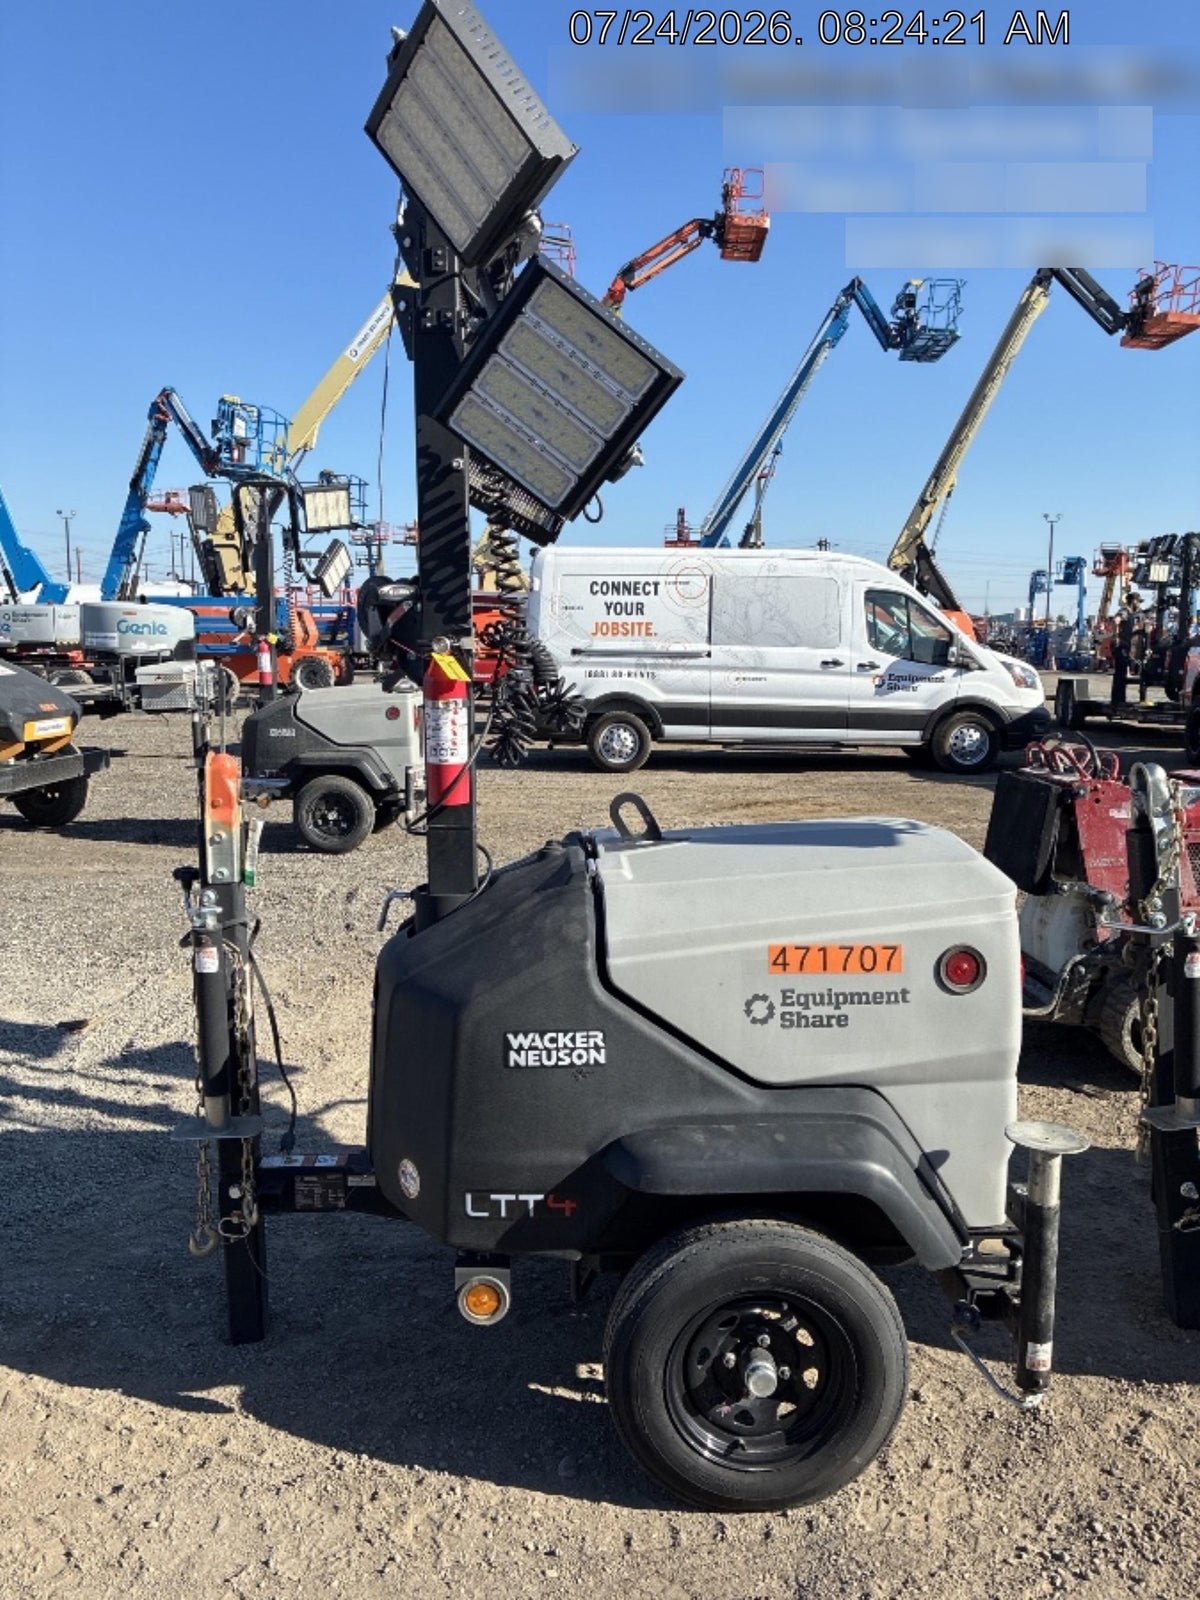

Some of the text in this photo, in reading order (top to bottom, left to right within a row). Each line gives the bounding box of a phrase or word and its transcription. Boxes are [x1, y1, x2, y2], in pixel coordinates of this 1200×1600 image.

[590, 581, 660, 596] CONNECT
[604, 602, 645, 616] YOUR
[116, 619, 168, 635] Genie
[591, 621, 659, 637] JOBSITE.
[888, 673, 945, 684] Equipment
[771, 945, 899, 973] 471707
[780, 988, 911, 1011] Equipment
[780, 1011, 849, 1029] Share
[506, 1031, 606, 1049] WACKER
[508, 1049, 607, 1067] NEUSON
[465, 1192, 577, 1218] LTT4
